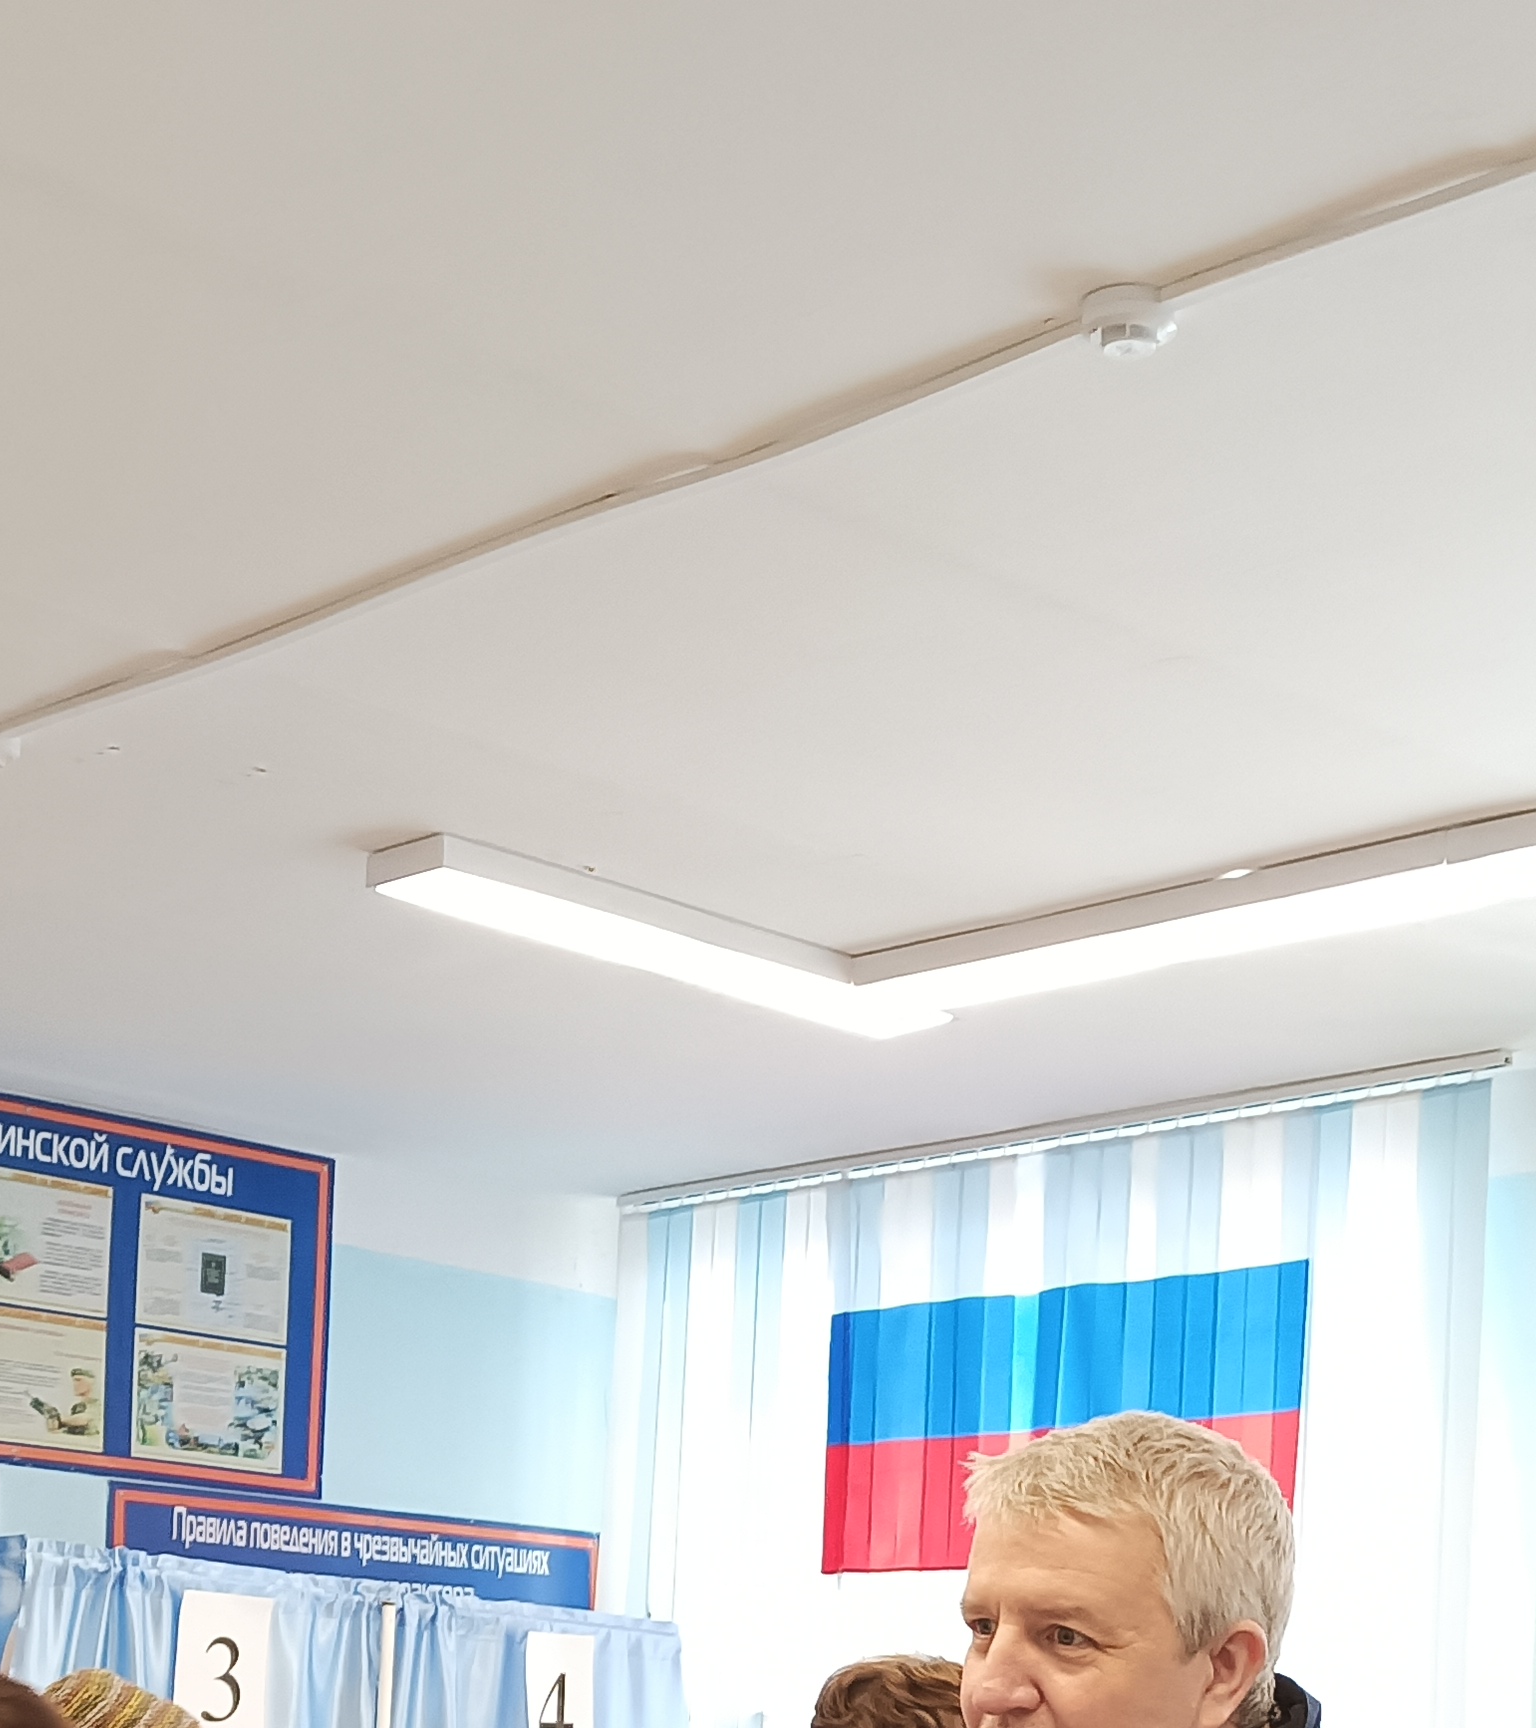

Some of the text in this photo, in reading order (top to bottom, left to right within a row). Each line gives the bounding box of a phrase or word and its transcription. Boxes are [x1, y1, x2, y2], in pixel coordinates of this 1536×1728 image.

[115, 1144, 235, 1198] службы
[171, 1505, 551, 1579] Правила поведения в чрезвычайных ситуациях
[200, 1635, 242, 1723] 3
